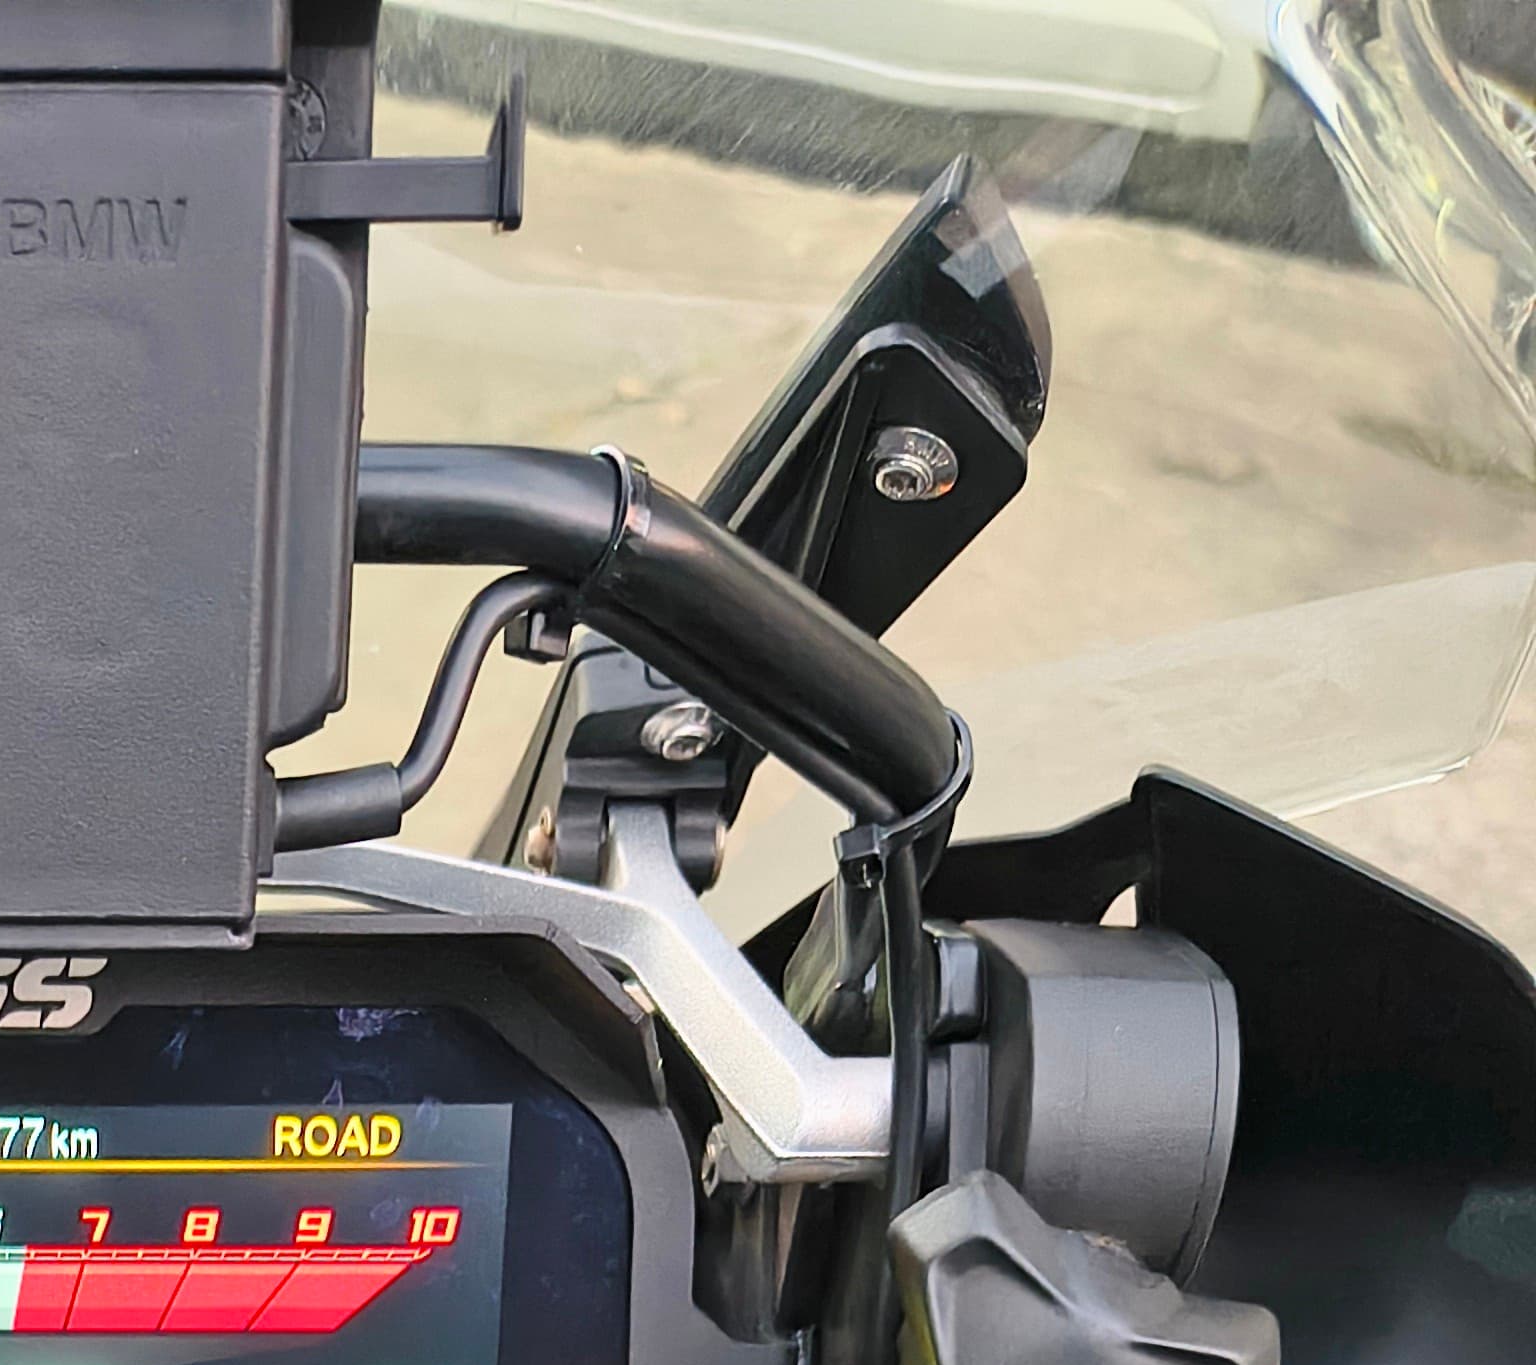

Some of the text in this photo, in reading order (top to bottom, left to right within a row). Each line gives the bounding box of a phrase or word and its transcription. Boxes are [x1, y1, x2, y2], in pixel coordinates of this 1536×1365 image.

[2, 197, 187, 262] BMW
[50, 1120, 99, 1159] km
[273, 1115, 401, 1158] ROAD
[81, 1207, 111, 1242] 7
[181, 1207, 220, 1242] 8
[295, 1207, 334, 1242] 9
[409, 1207, 459, 1242] 10
